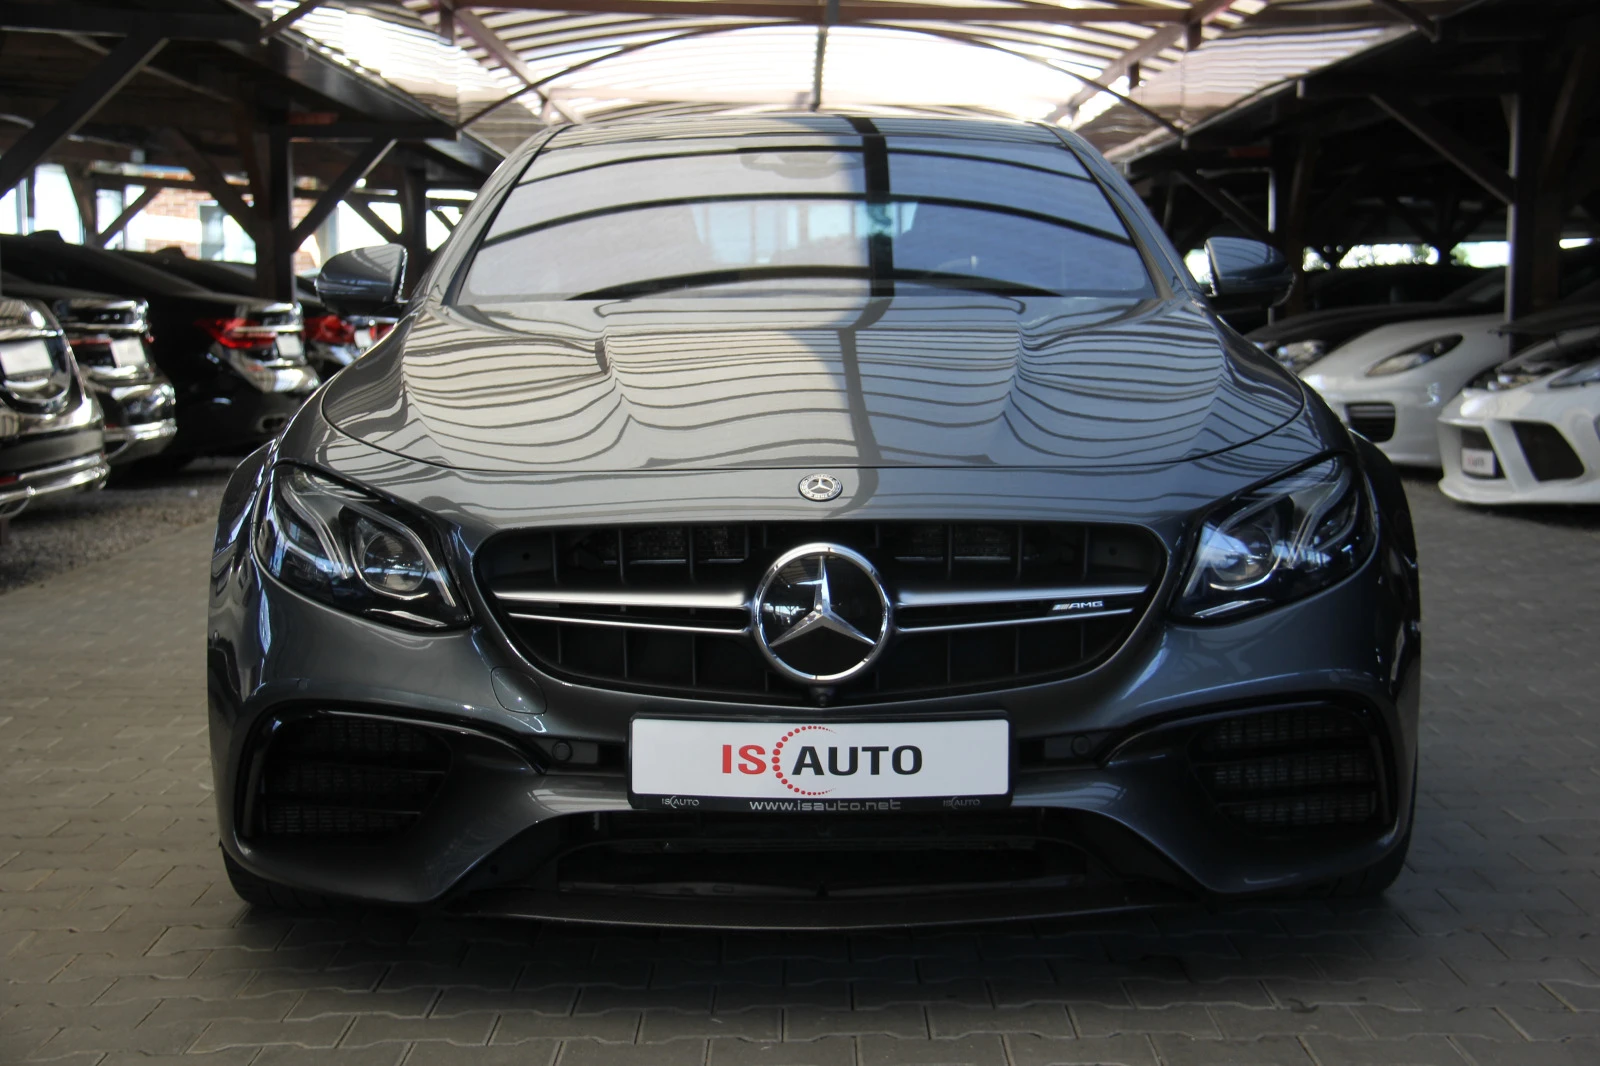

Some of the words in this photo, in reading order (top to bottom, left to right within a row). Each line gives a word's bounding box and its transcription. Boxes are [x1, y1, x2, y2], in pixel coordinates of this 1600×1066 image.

[1068, 600, 1104, 610] AMG
[722, 744, 767, 775] IS
[792, 745, 923, 776] AUTO
[749, 799, 901, 811] www.isauto.net
